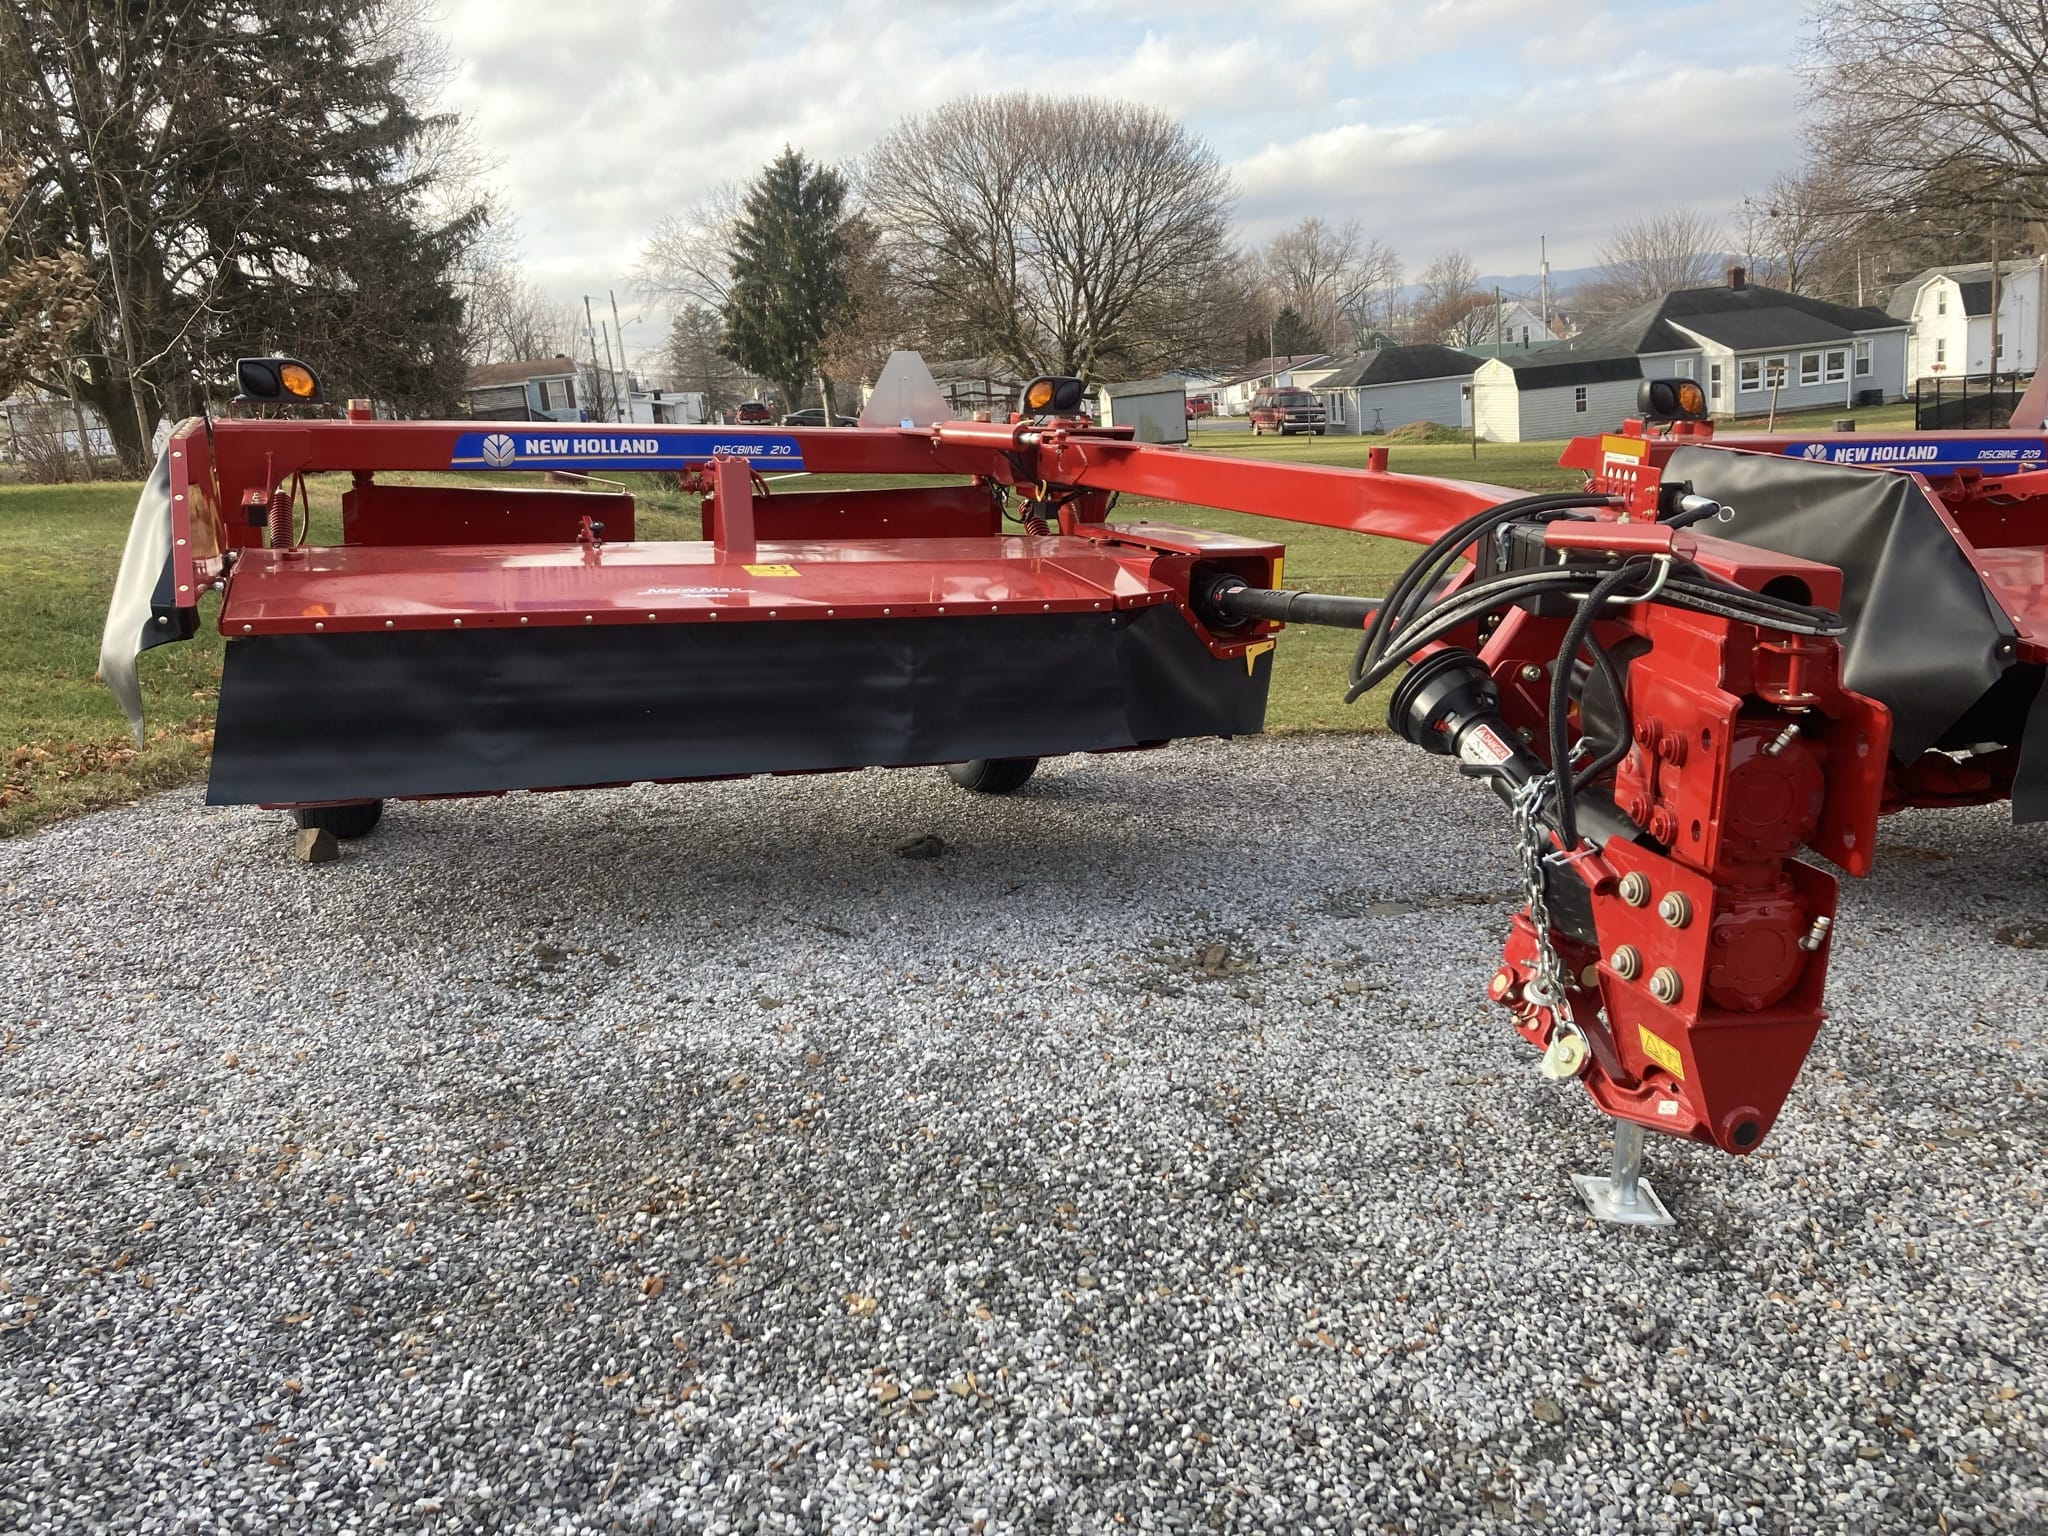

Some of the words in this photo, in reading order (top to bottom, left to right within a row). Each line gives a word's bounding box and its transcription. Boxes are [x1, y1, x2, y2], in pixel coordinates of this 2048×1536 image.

[525, 439, 569, 454] NEW
[573, 439, 659, 454] HOLLAND
[712, 445, 764, 455] DISCBINE
[769, 445, 791, 455] 210
[1834, 447, 1869, 462] NEW
[1870, 445, 1938, 461] HOLLAND
[1977, 449, 2019, 459] DISCBINE
[2021, 449, 2042, 459] 209
[1483, 733, 1508, 760] DANGER
